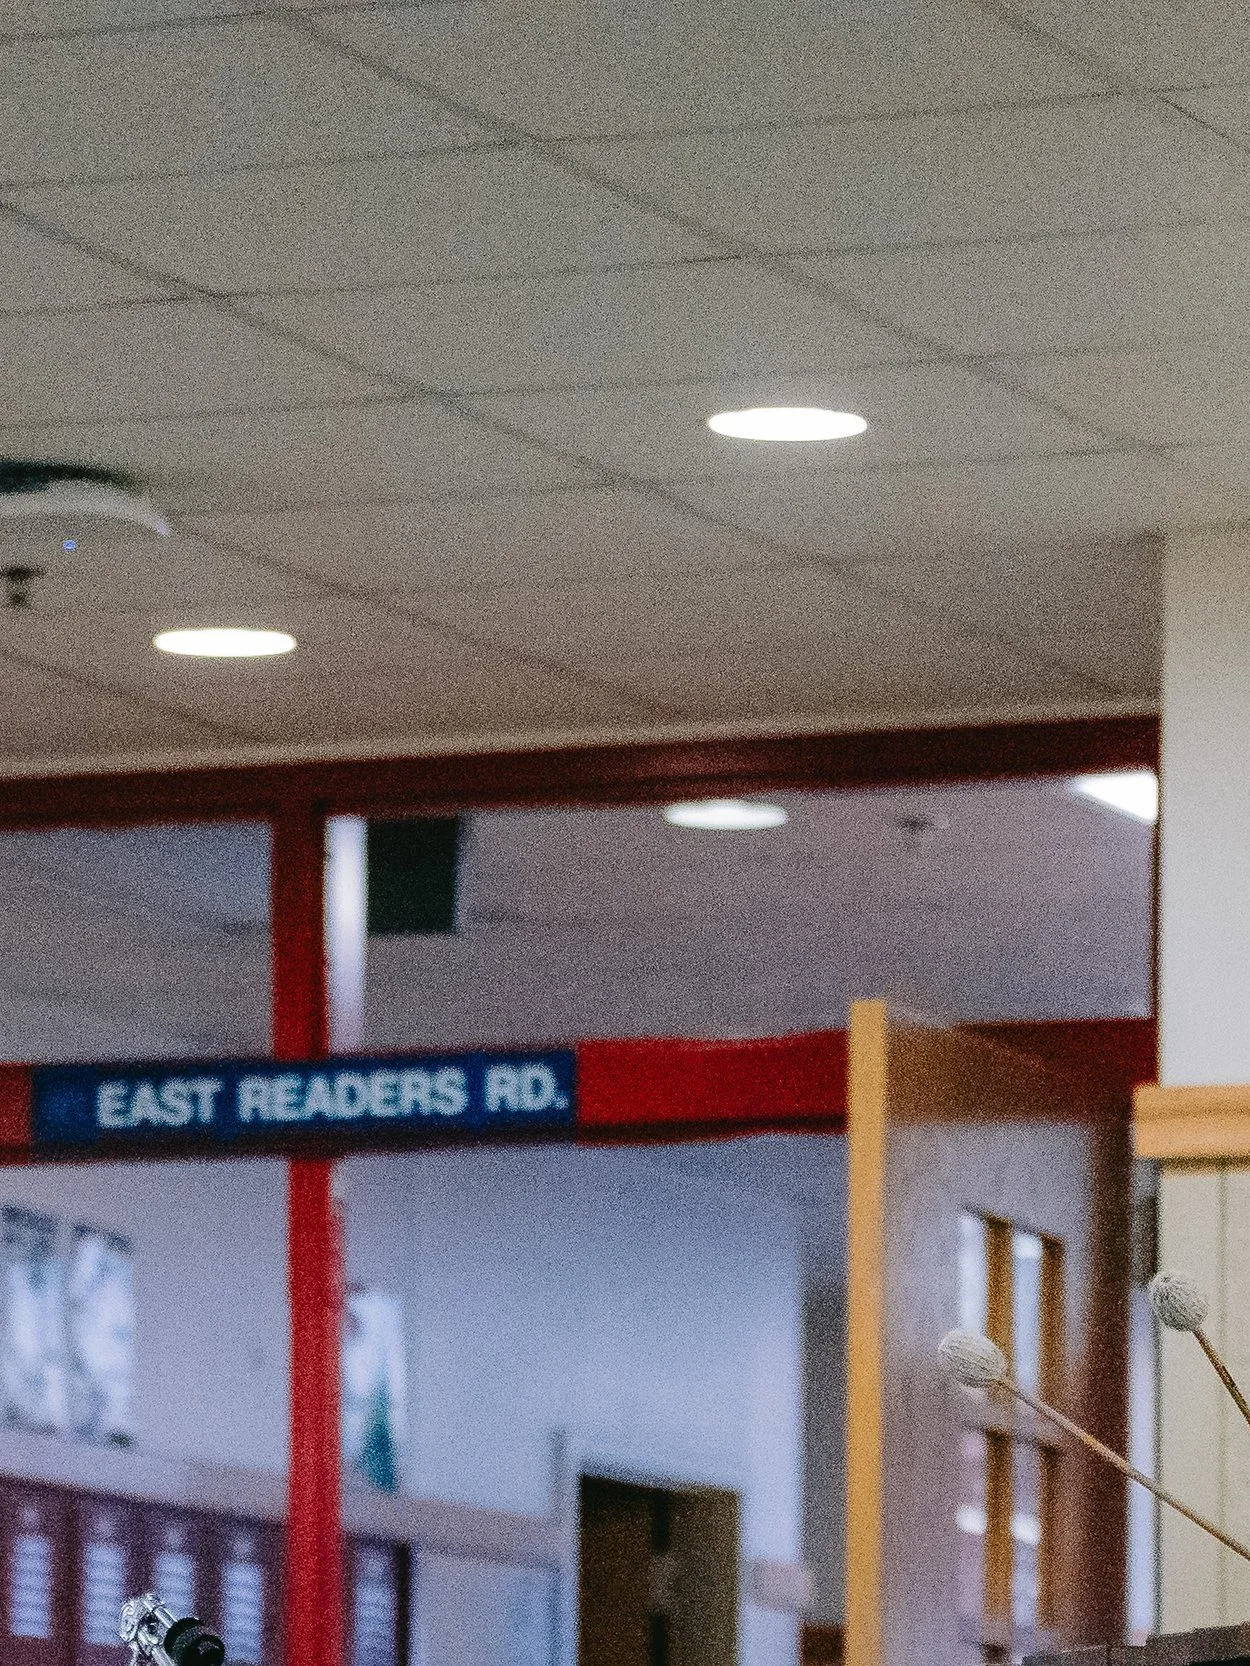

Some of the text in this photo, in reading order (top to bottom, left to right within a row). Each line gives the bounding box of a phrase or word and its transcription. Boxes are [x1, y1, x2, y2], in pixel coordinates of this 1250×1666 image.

[98, 1063, 569, 1128] EAST READERS RD.
